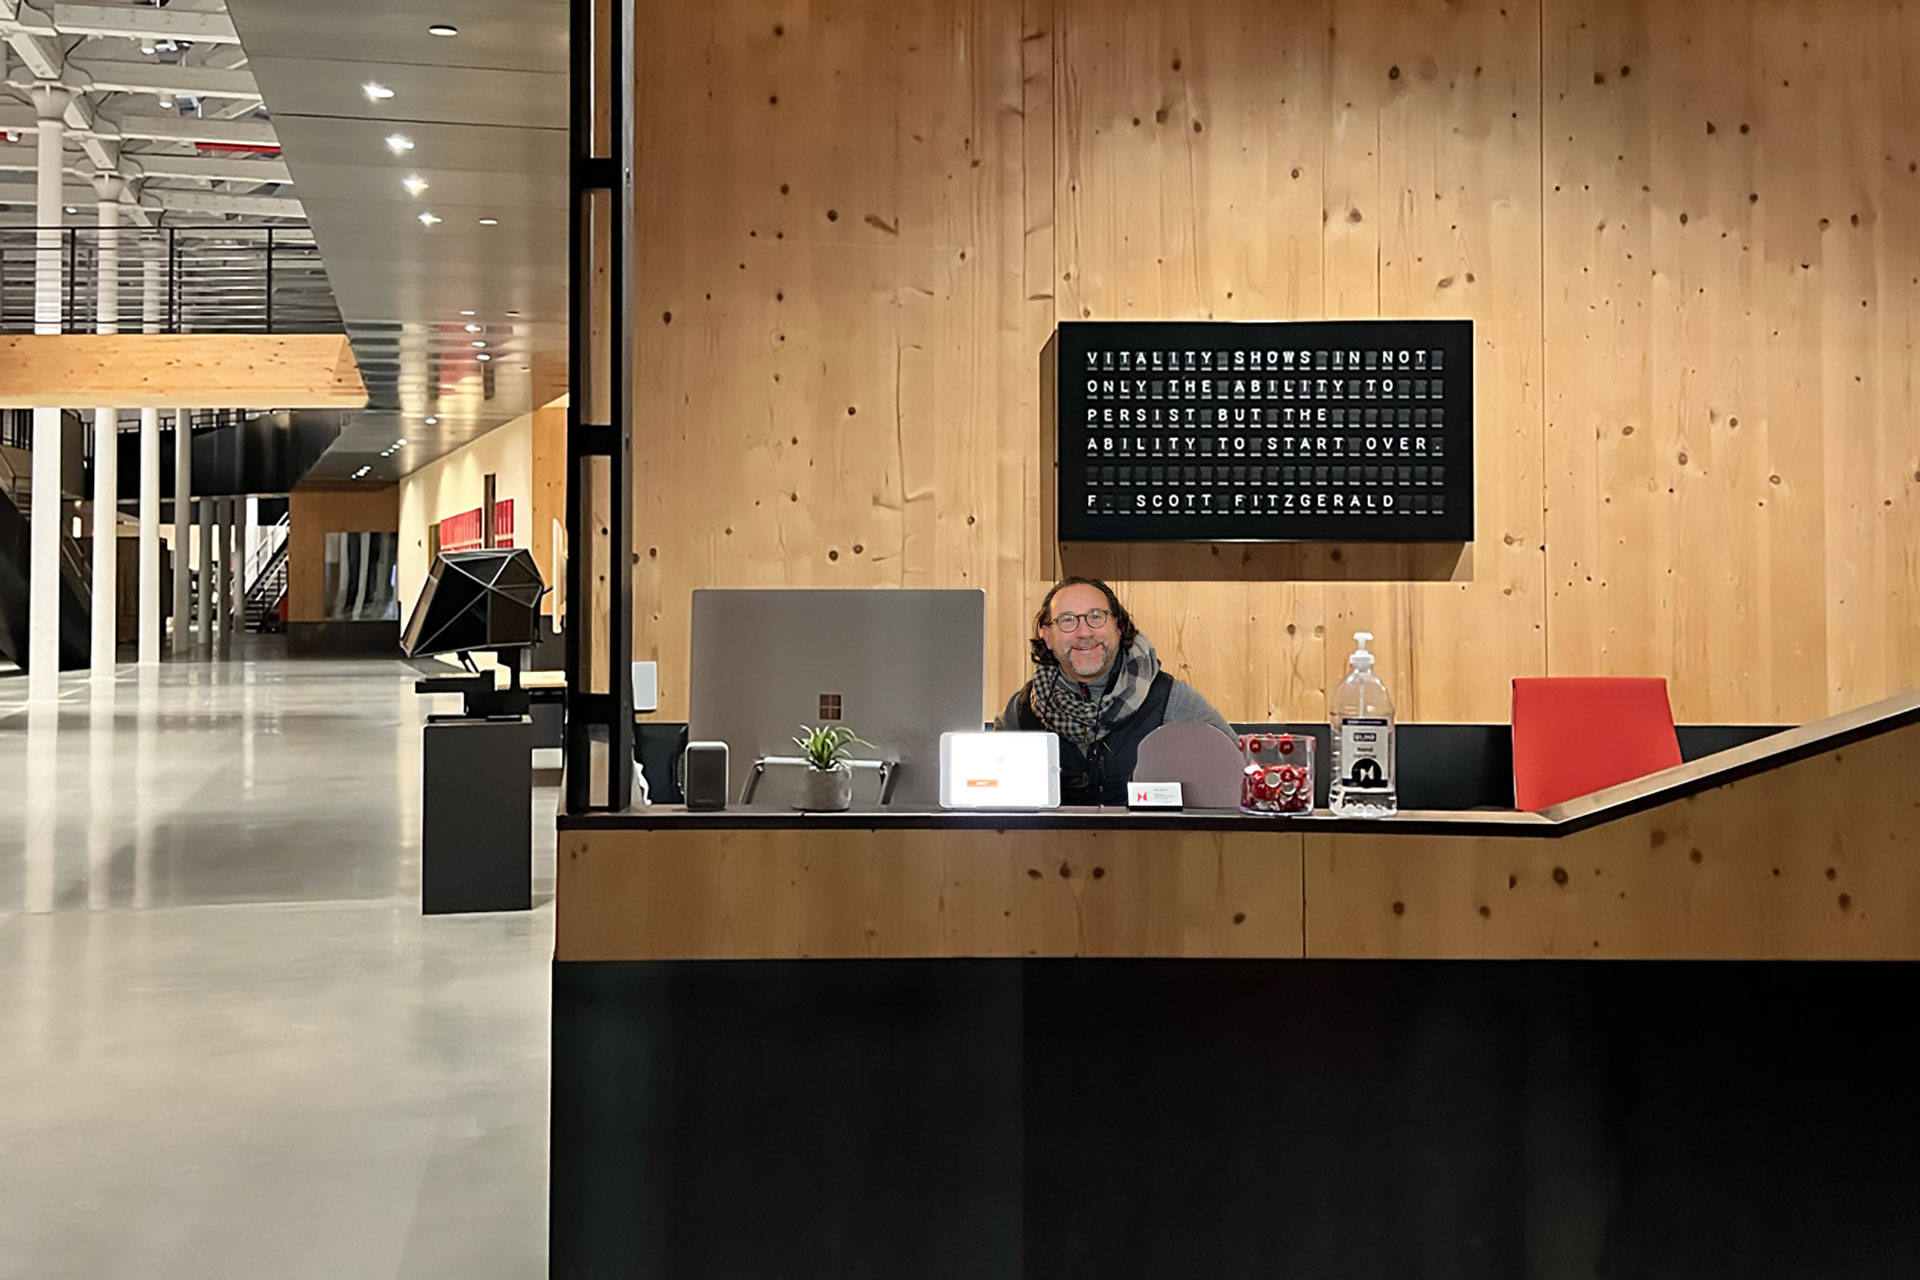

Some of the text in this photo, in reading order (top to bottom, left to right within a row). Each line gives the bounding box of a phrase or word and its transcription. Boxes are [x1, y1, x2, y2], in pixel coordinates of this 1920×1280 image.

[1087, 351, 1426, 364] VITALITY SHOWS IN NOT
[1088, 380, 1393, 392] ONLY THE ABILITY TO
[1088, 408, 1326, 421] PERSIST BUT THE
[1088, 437, 1439, 450] ABILITY TO START OVER.
[1137, 494, 1211, 507] SCOTT
[1235, 494, 1393, 507] FITZGERALD
